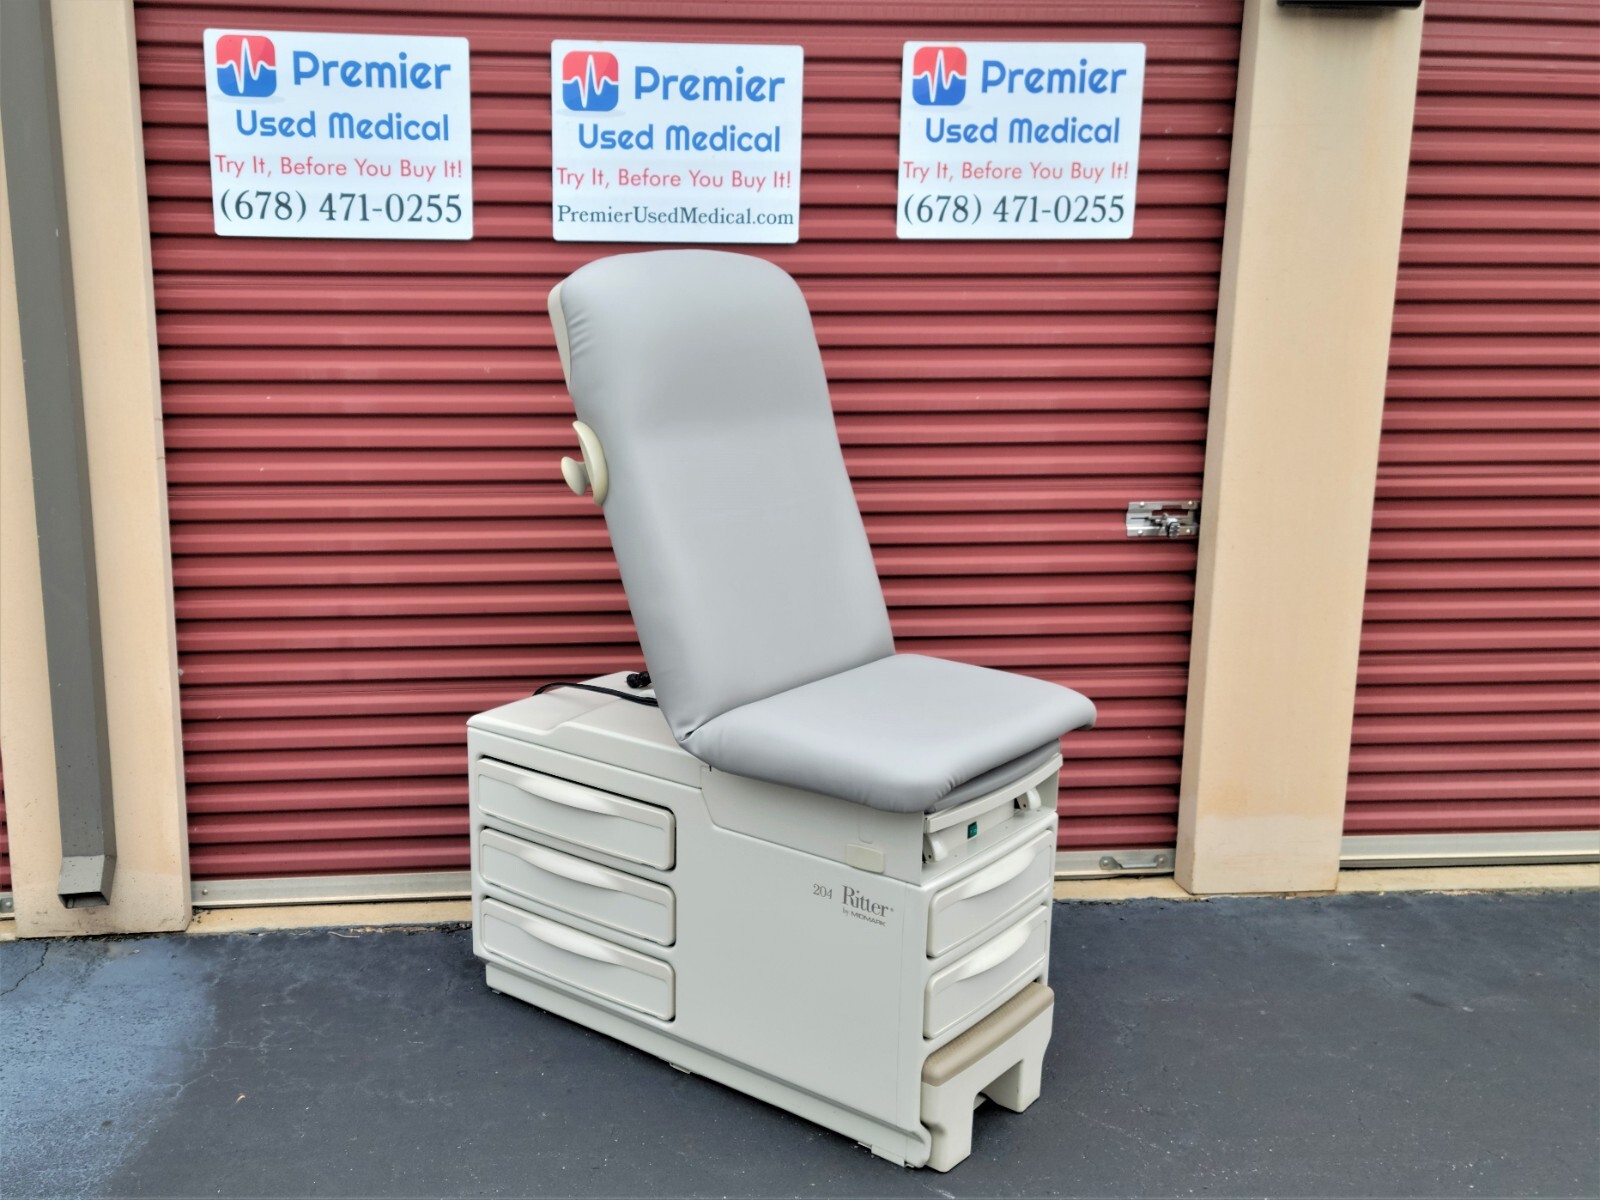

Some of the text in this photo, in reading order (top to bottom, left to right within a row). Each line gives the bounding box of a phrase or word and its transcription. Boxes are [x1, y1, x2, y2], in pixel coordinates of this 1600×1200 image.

[292, 50, 451, 90] Premier
[634, 66, 785, 102] Premier
[981, 58, 1127, 94] Premier
[236, 110, 449, 141] Used Medical
[578, 123, 780, 152] Used Medical
[925, 117, 1120, 143] Used Medical
[215, 155, 462, 182] Try It, Before You Buy It!
[557, 167, 791, 192] Try It, Before You Buy It!
[903, 161, 1128, 183] Try It, Before You Buy It!
[220, 189, 462, 223] (678) 471-0255
[557, 205, 794, 225] PremierUsedMedical.com
[904, 194, 1124, 224] (678) 471-0255
[813, 884, 832, 900] 204
[842, 907, 886, 927] by MIDMARK
